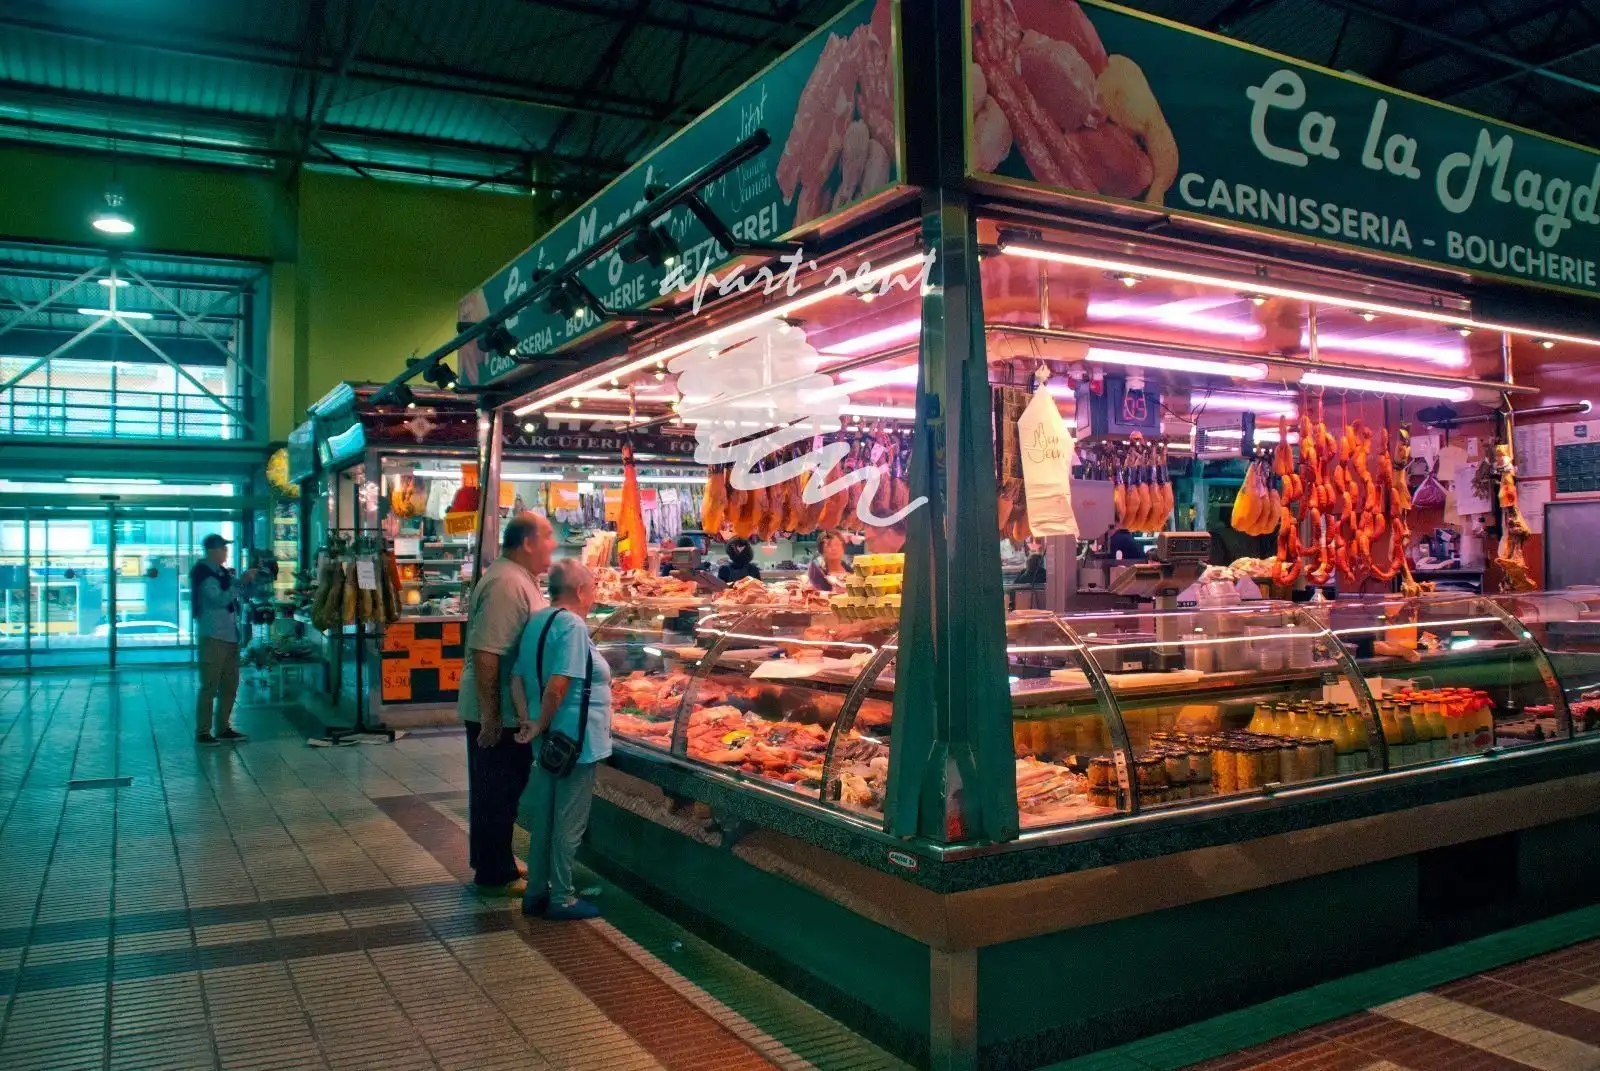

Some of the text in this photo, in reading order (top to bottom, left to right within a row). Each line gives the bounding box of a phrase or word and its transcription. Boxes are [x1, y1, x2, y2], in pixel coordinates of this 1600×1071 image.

[1246, 69, 1340, 167] Ca
[1361, 98, 1421, 179] la
[1179, 171, 1413, 250] CARNISSERIA
[1446, 230, 1598, 287] BOUCHERIE
